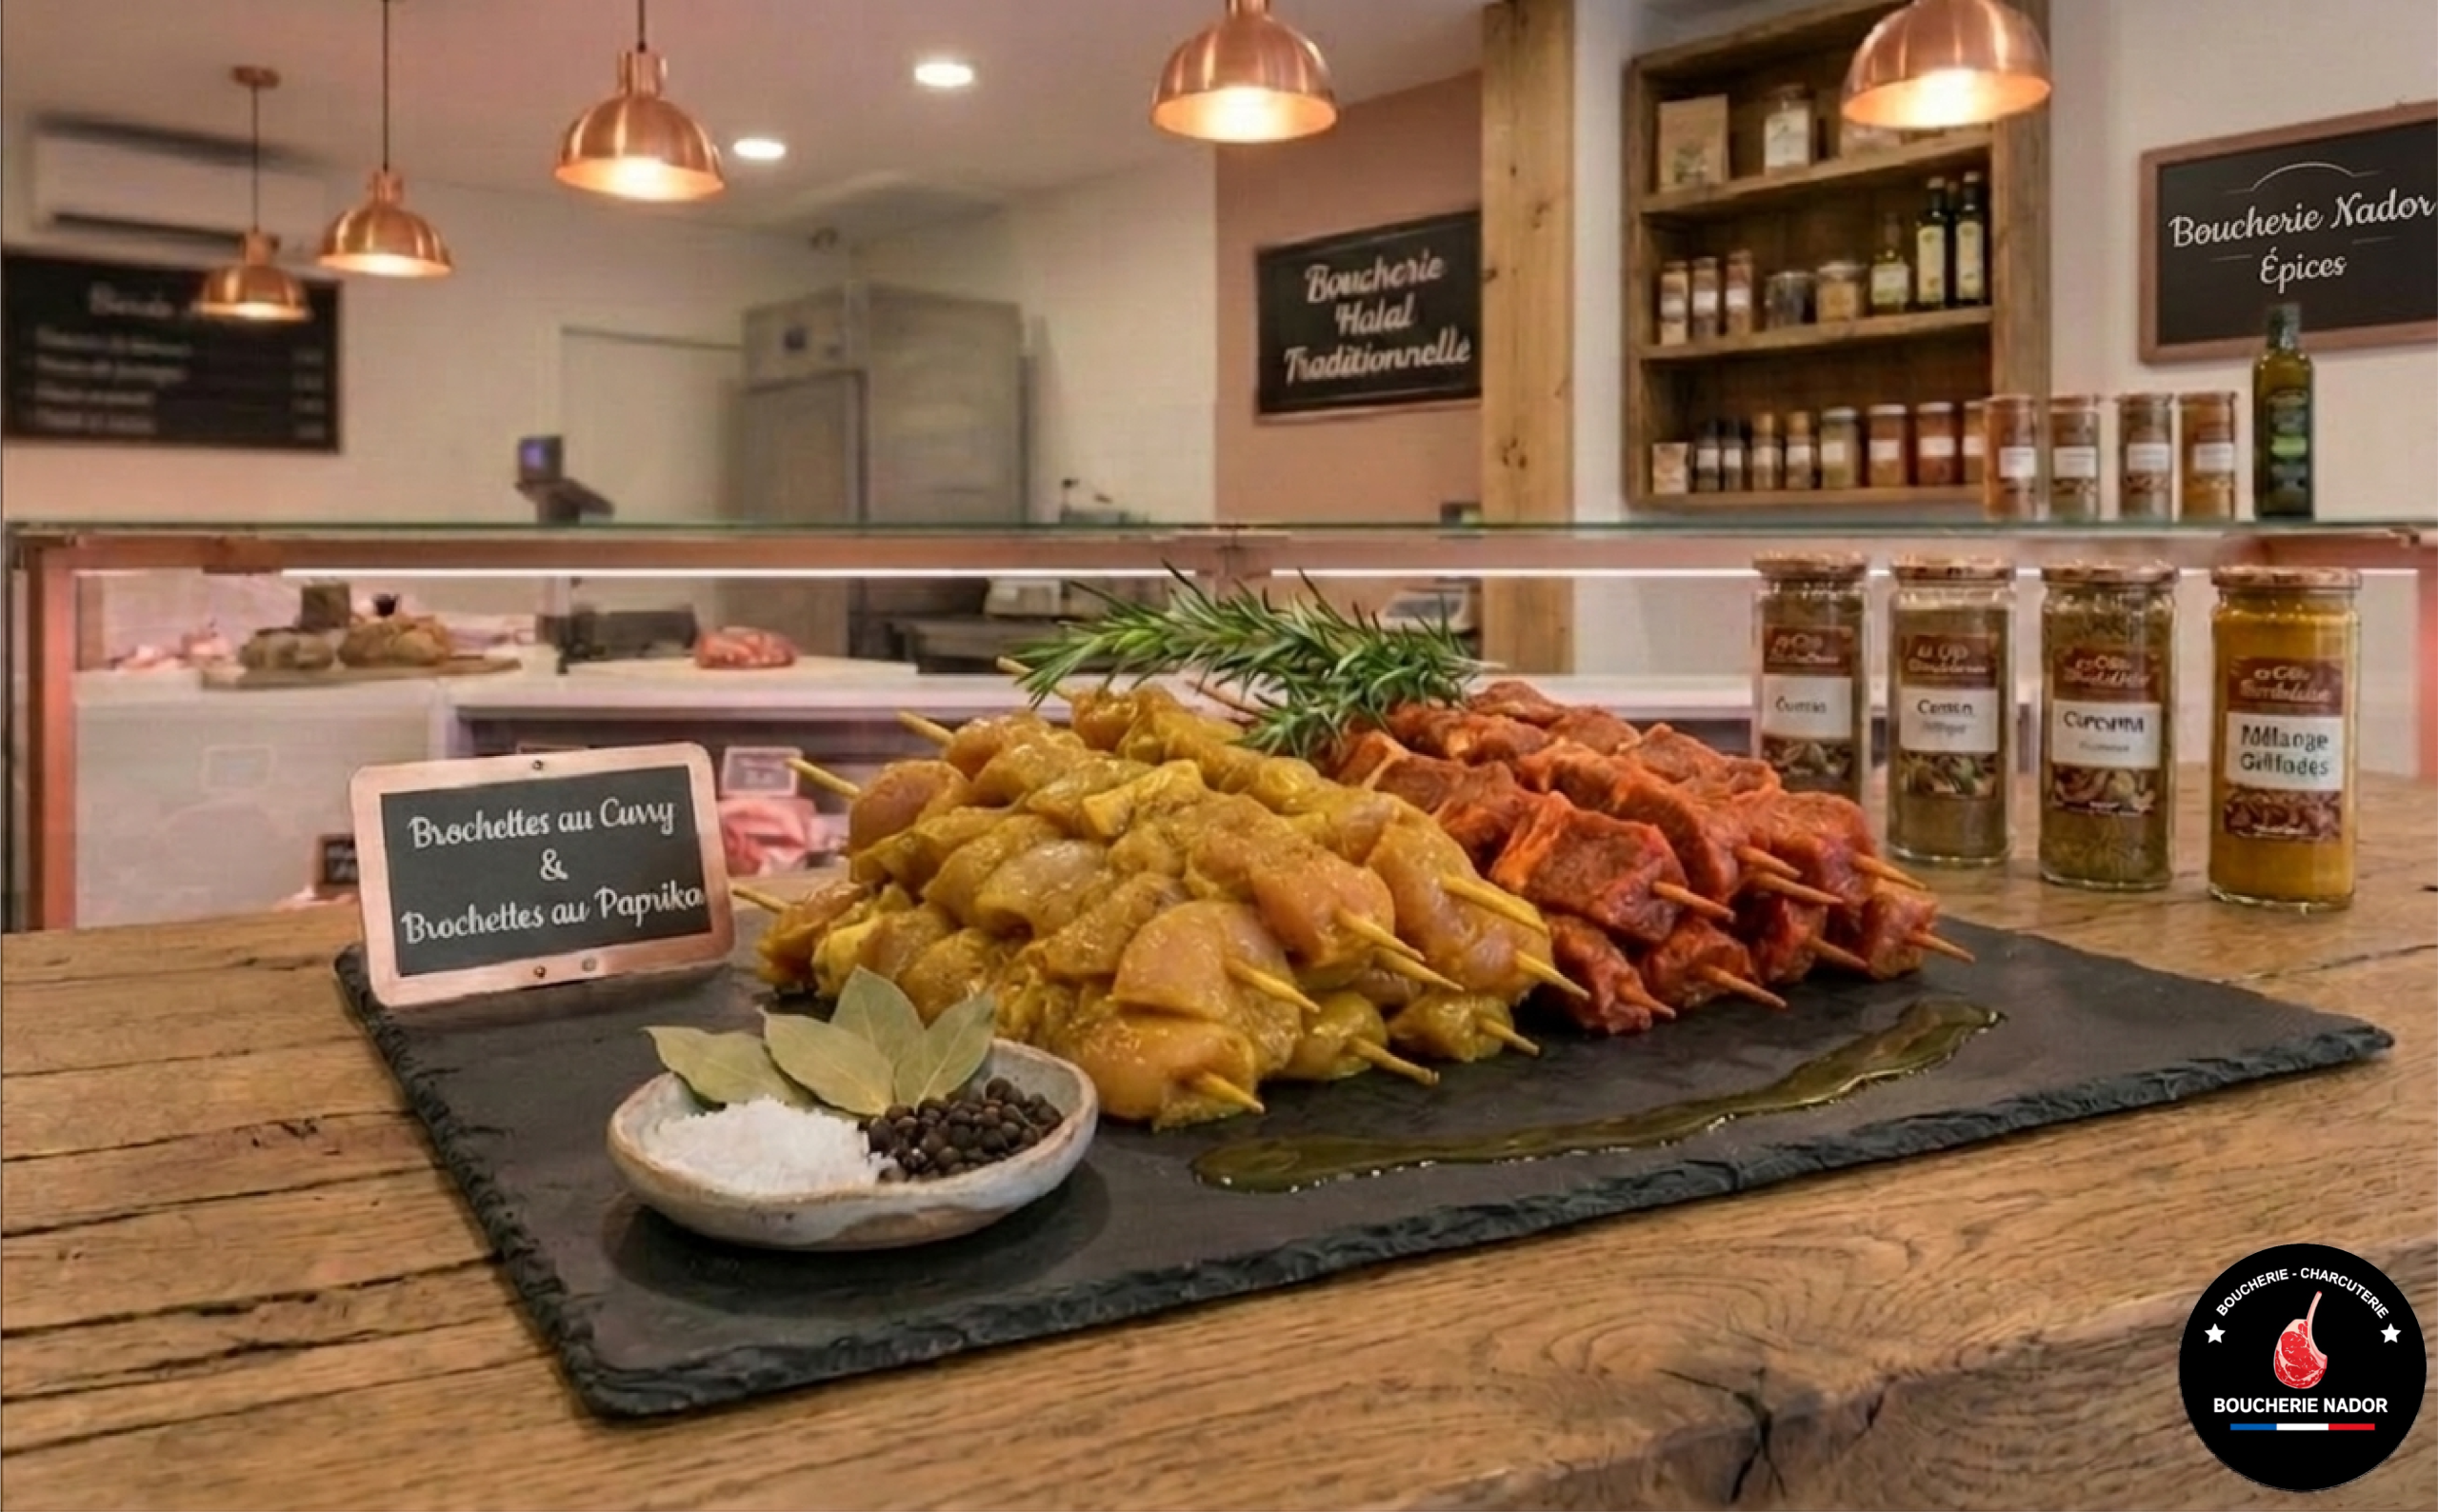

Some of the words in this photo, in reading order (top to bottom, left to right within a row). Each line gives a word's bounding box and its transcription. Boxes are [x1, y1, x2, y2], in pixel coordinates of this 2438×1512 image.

[2168, 203, 2323, 248] Boucherie
[2330, 188, 2438, 229] Nador
[1305, 248, 1446, 304] Boucherie
[2260, 247, 2348, 294] Épices
[1335, 292, 1416, 336] Halal
[1285, 326, 1470, 386] Traditionnelle
[408, 809, 550, 849] Brochettes
[558, 810, 593, 830] au
[600, 797, 674, 835] Curry
[540, 848, 569, 881] &
[401, 902, 543, 944] Brochettes
[551, 903, 590, 925] au
[594, 881, 705, 927] Paprika
